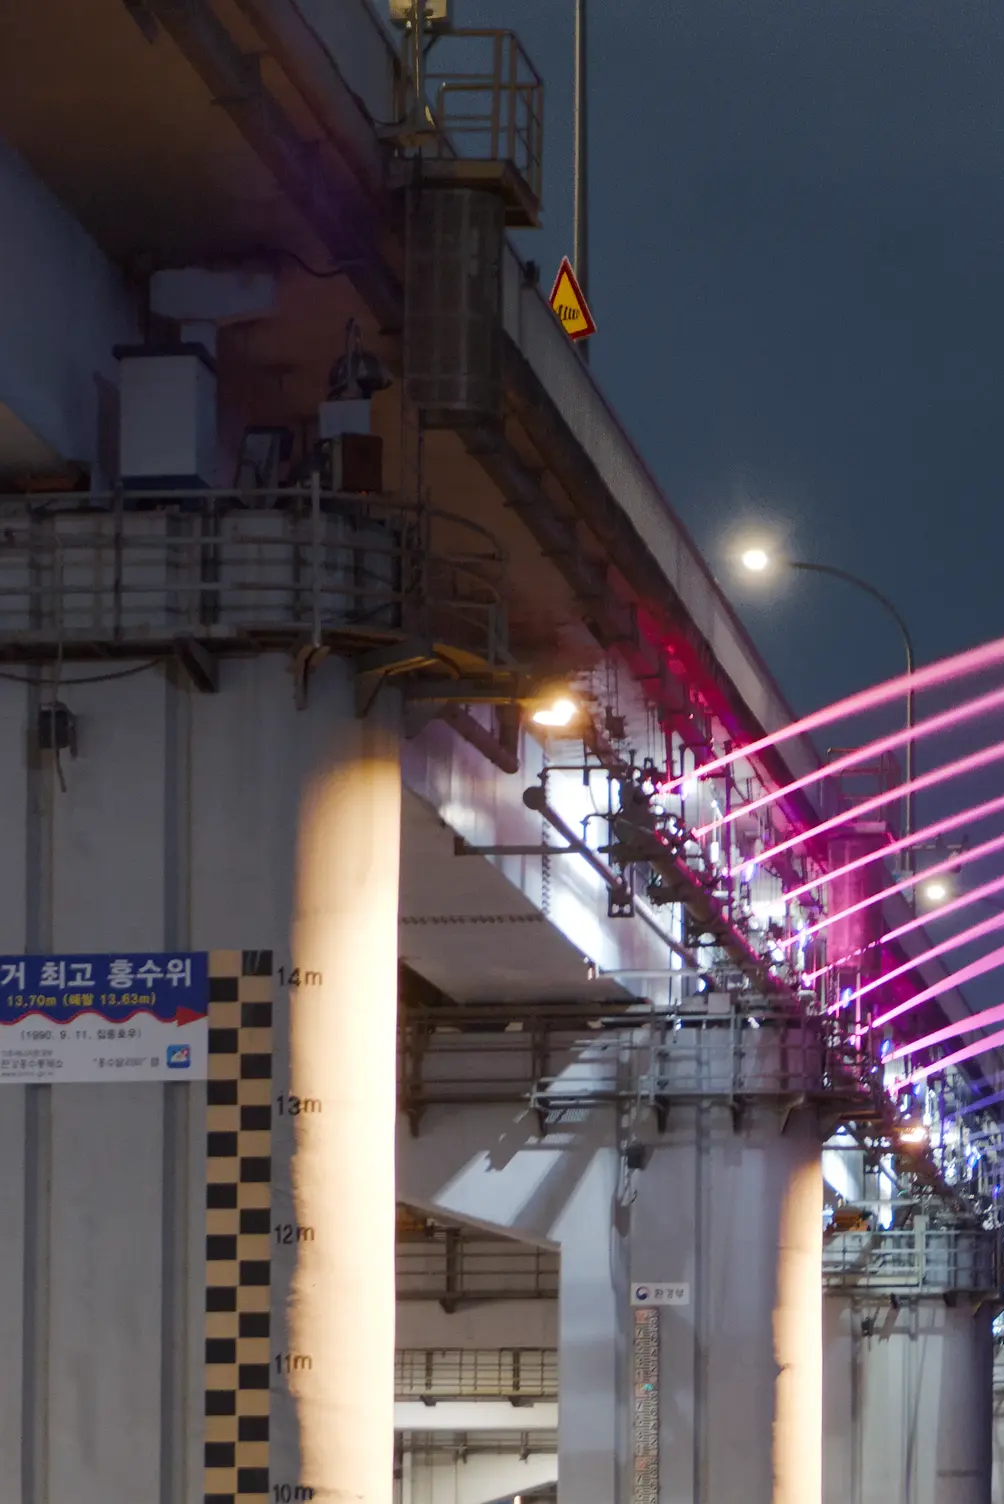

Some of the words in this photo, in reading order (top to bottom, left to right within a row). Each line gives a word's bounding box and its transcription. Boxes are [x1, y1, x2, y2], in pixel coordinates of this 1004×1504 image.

[39, 961, 96, 990] 최고
[108, 958, 192, 988] 홍수위
[277, 966, 322, 986] 14m
[277, 1094, 322, 1116] 13m
[274, 1224, 315, 1244] 12m
[275, 1353, 312, 1374] 11m
[273, 1483, 314, 1503] 10m
